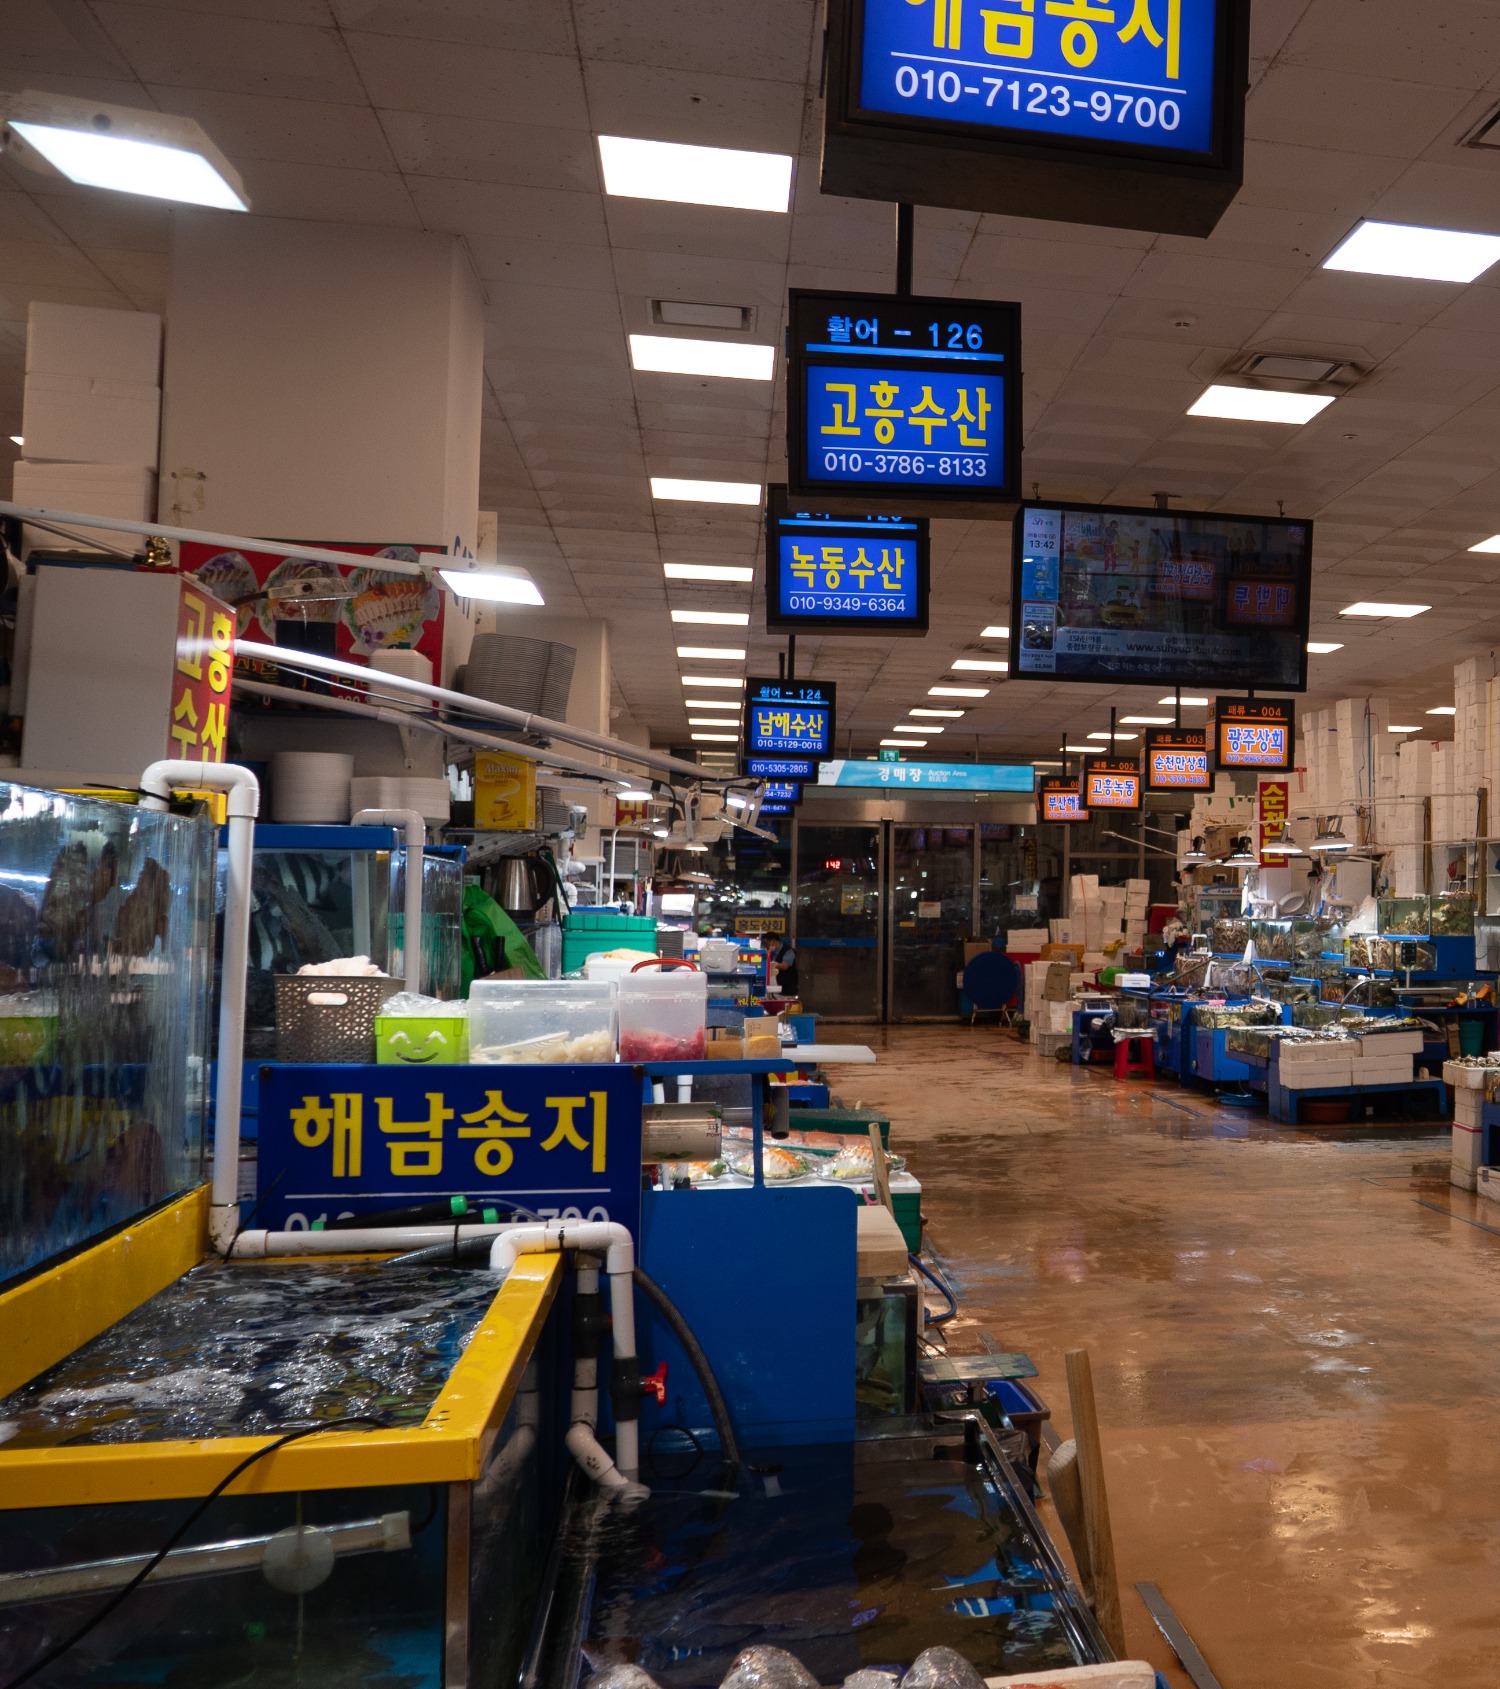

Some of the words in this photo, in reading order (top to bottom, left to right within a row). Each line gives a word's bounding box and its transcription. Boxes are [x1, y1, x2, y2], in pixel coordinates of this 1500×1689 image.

[895, 65, 1180, 131] 010-7123-9700
[827, 316, 878, 344] 활어
[928, 322, 983, 349] 126
[820, 380, 992, 447] 고흥수산
[824, 453, 987, 477] 010-3786-8133
[1030, 540, 1054, 549] 13:42
[790, 546, 905, 590] 녹동수산
[790, 596, 906, 612] 010-9349-6364
[177, 592, 232, 693] 고흥
[760, 686, 781, 699] 활어
[799, 689, 822, 700] 124
[1228, 705, 1246, 716] 패류
[1261, 707, 1281, 717] 004
[758, 712, 823, 738] 남해수산
[757, 739, 823, 750] 010-5129-0018
[1157, 735, 1172, 743] 패류
[1186, 735, 1204, 744] 003
[1227, 728, 1284, 753] 광주상회
[486, 763, 519, 773] Maxim
[752, 763, 808, 773] 010-5305-2805
[1154, 754, 1207, 772] 순천만상회
[878, 767, 923, 783] 경매장
[1091, 778, 1135, 797] 고흥녹동
[1048, 795, 1080, 811] 부산해
[290, 1090, 608, 1178] 해남송지
